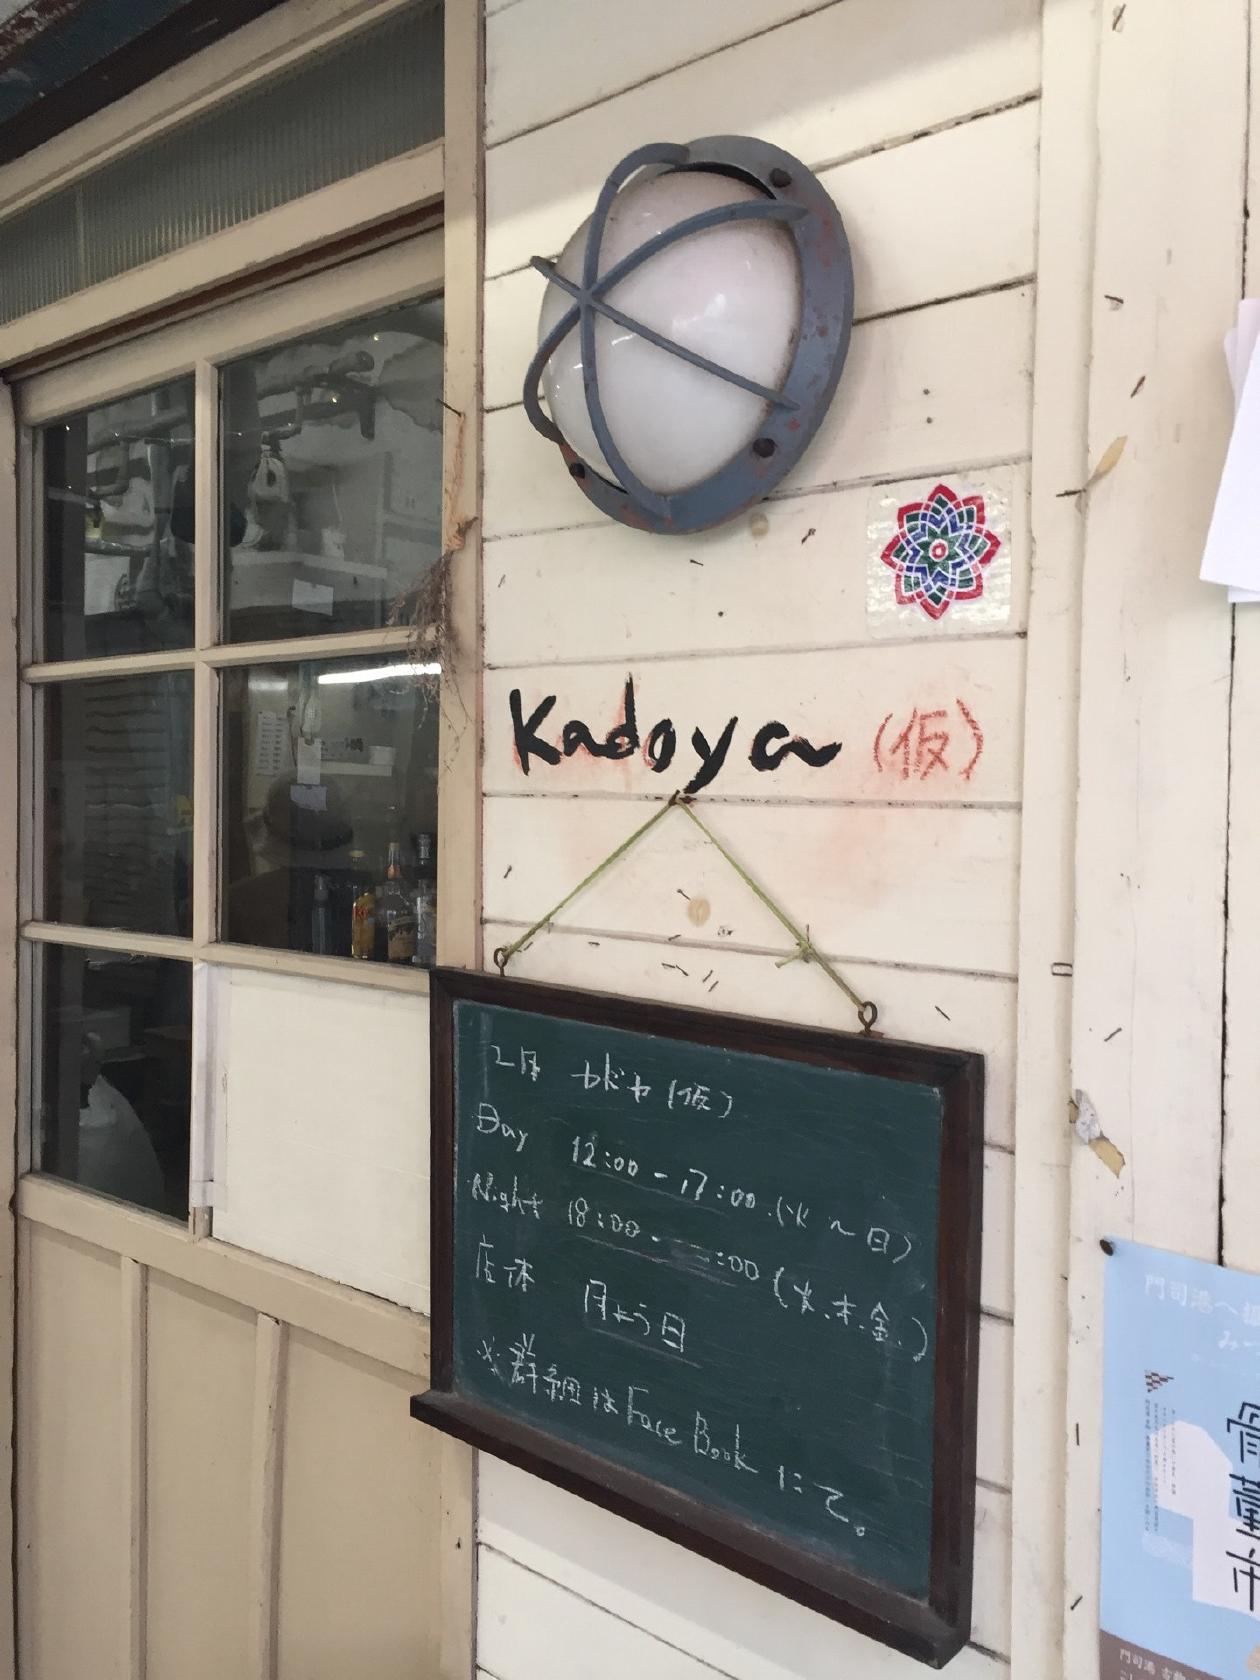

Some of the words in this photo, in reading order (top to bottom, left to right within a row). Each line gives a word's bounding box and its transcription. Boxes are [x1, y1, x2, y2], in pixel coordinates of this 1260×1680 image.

[509, 671, 843, 795] Kadoya
[870, 697, 984, 783] (仮)
[476, 1101, 529, 1153] Day
[572, 1135, 640, 1177] 12:00
[680, 1167, 756, 1209] 17:00
[470, 1172, 544, 1220] Night
[567, 1197, 641, 1238] 18:00
[693, 1410, 759, 1473] Book
